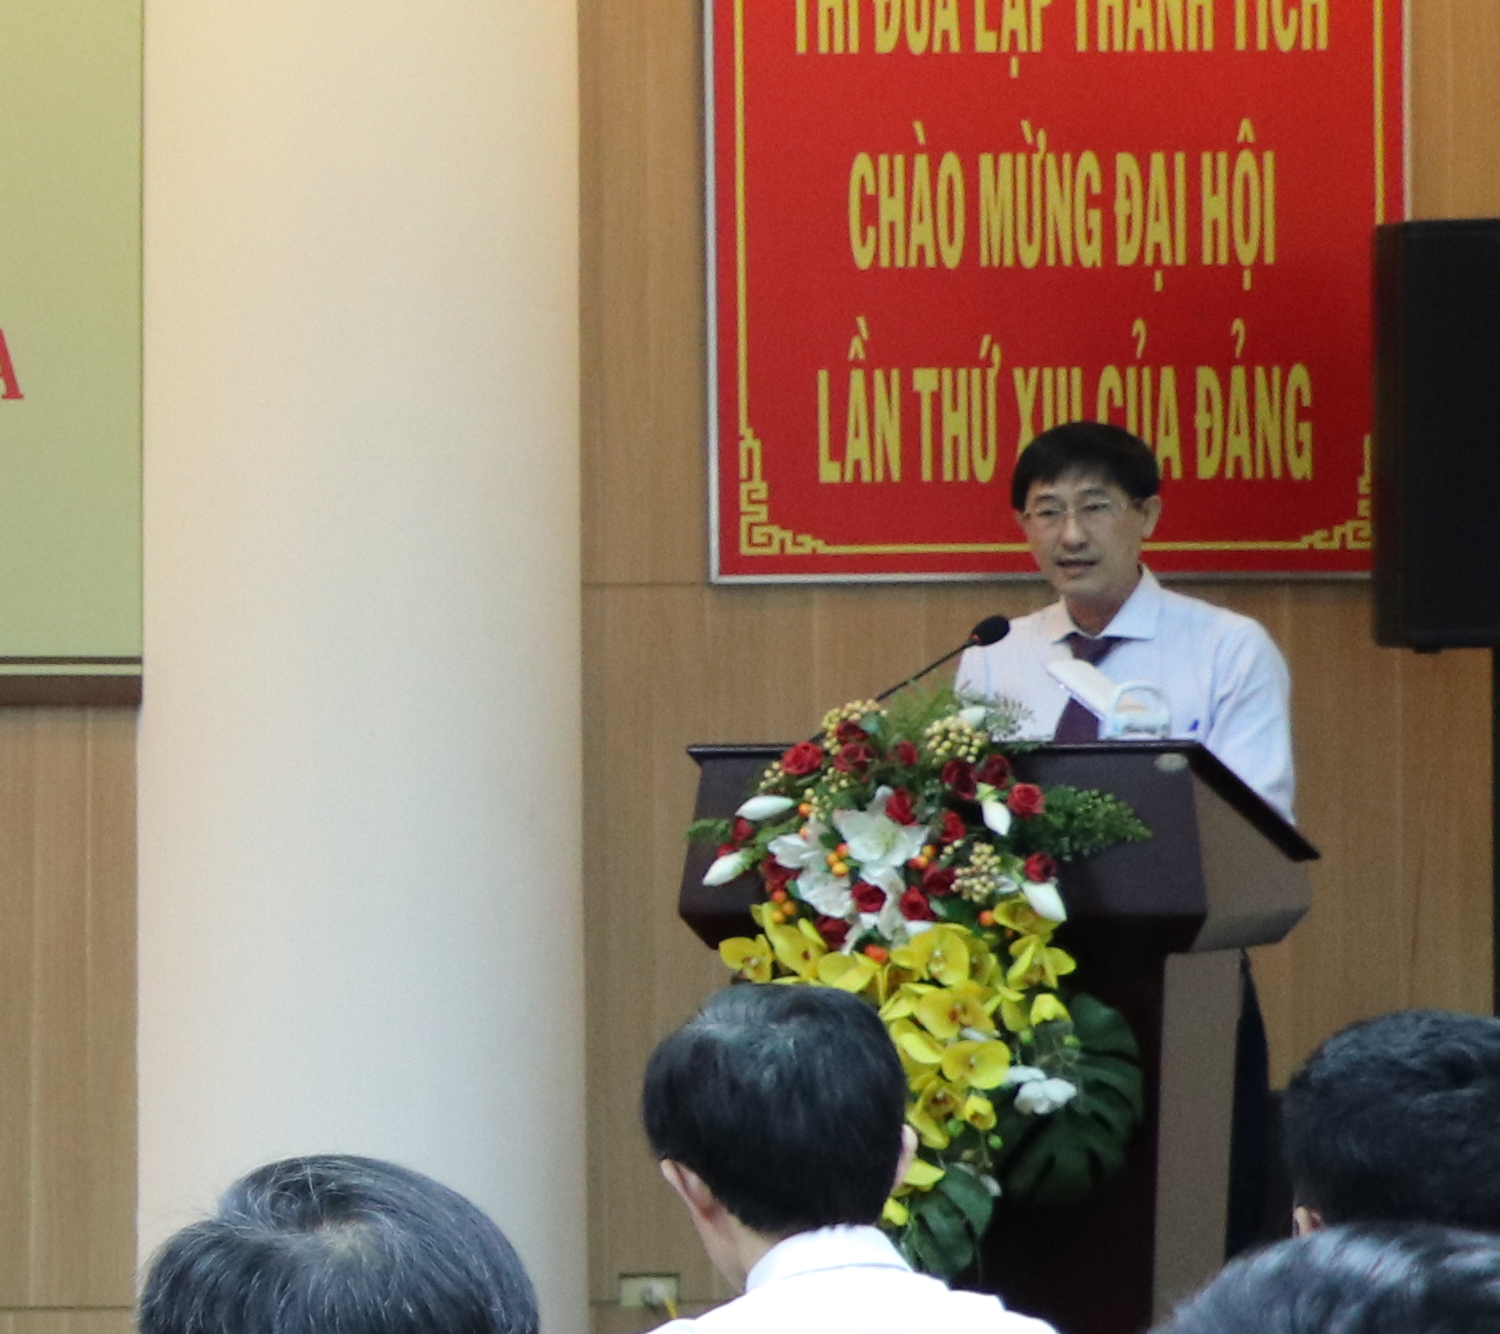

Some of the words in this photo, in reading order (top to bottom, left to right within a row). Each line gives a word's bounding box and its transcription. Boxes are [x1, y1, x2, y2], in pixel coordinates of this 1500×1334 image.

[848, 119, 965, 270] CHÀO
[979, 119, 1102, 269] MỪNG
[1114, 151, 1187, 291] ĐẠI
[1202, 117, 1276, 290] HỘI
[817, 315, 902, 483] LẦN
[912, 334, 1002, 483] THỨ
[1194, 317, 1312, 480] ĐẢNG
